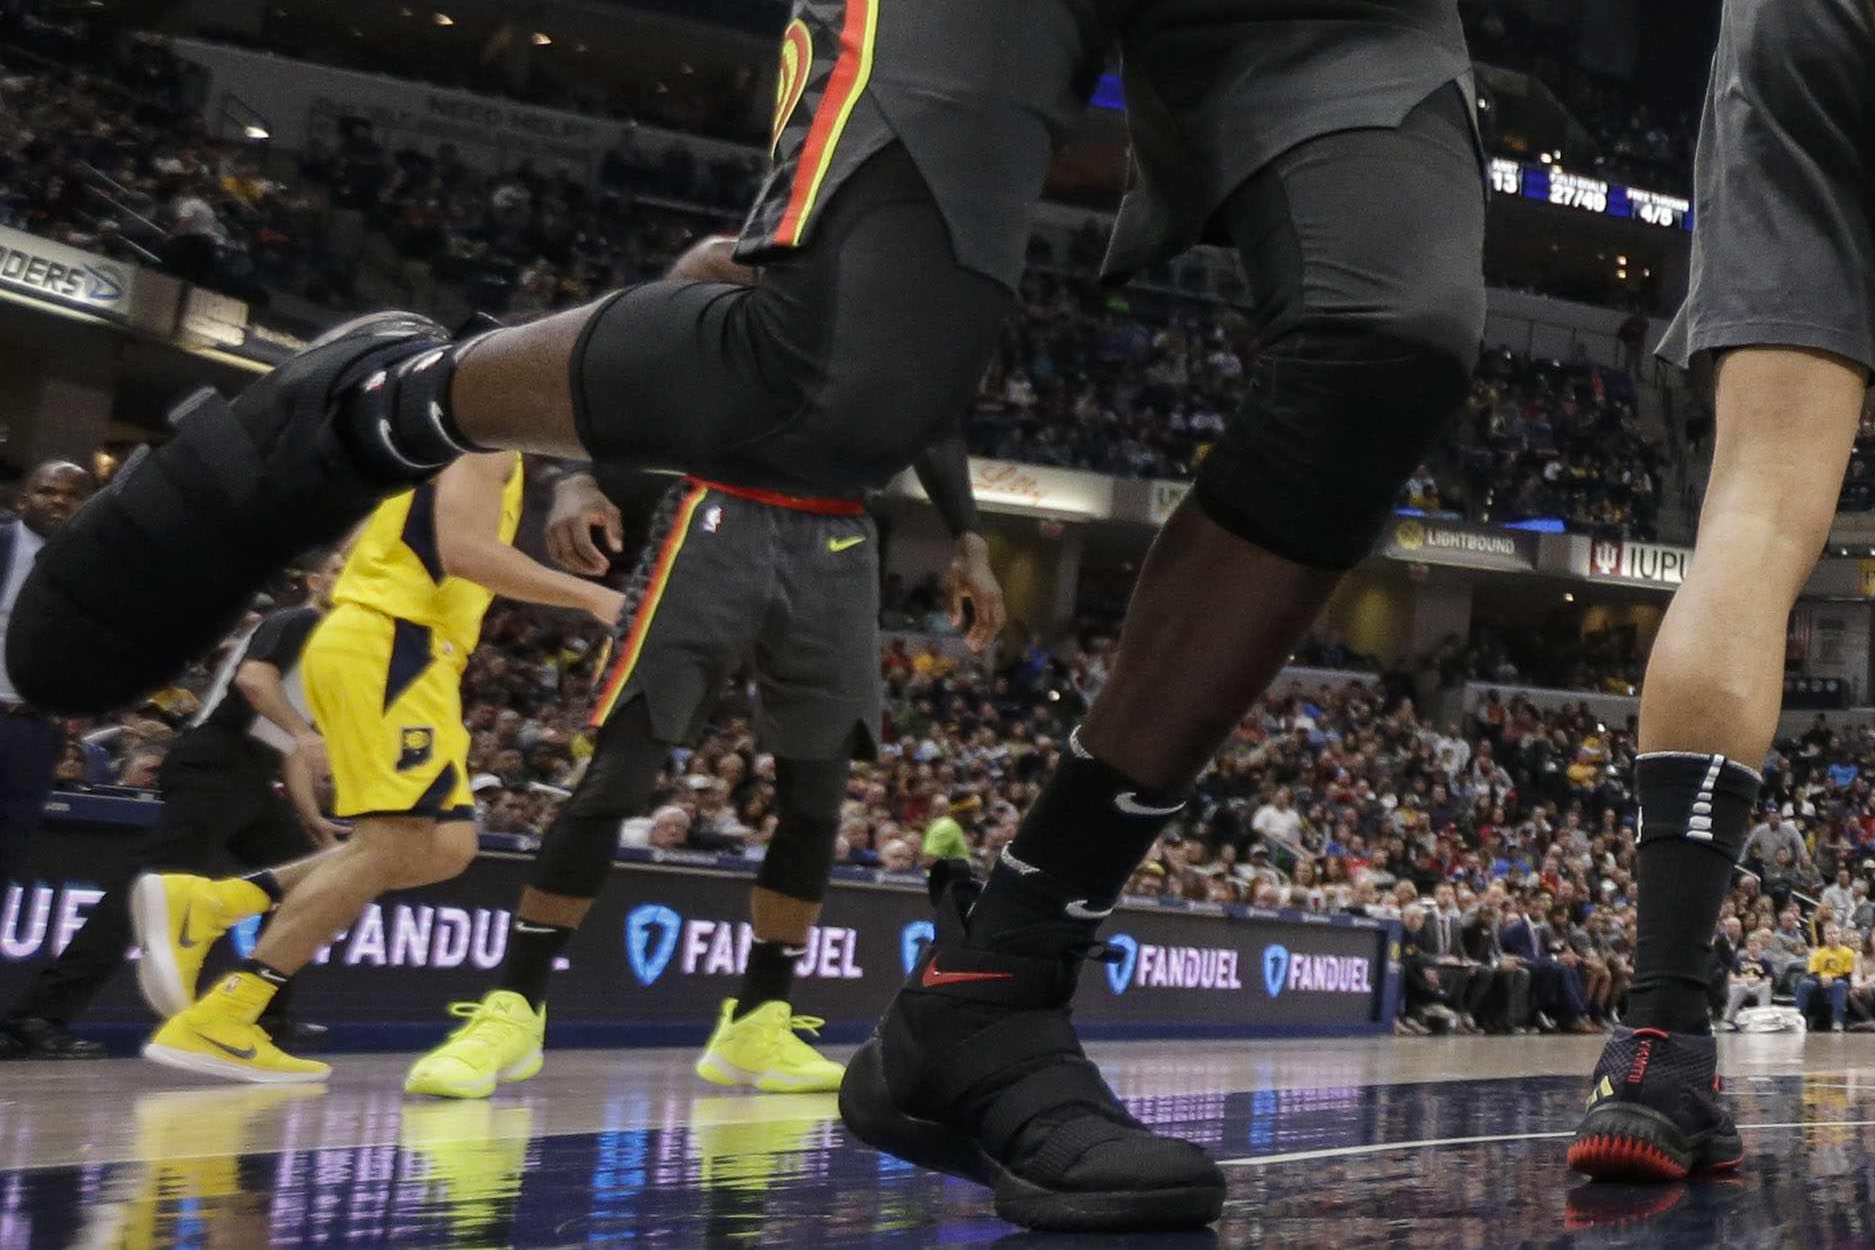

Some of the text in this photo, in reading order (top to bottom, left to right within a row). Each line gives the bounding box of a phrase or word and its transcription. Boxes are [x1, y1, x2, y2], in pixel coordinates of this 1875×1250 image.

[1491, 171, 1519, 194] 13
[1427, 529, 1516, 556] LIGHTBOUND
[1135, 943, 1242, 991] FANDUEL
[1288, 952, 1373, 994] FANDUEL
